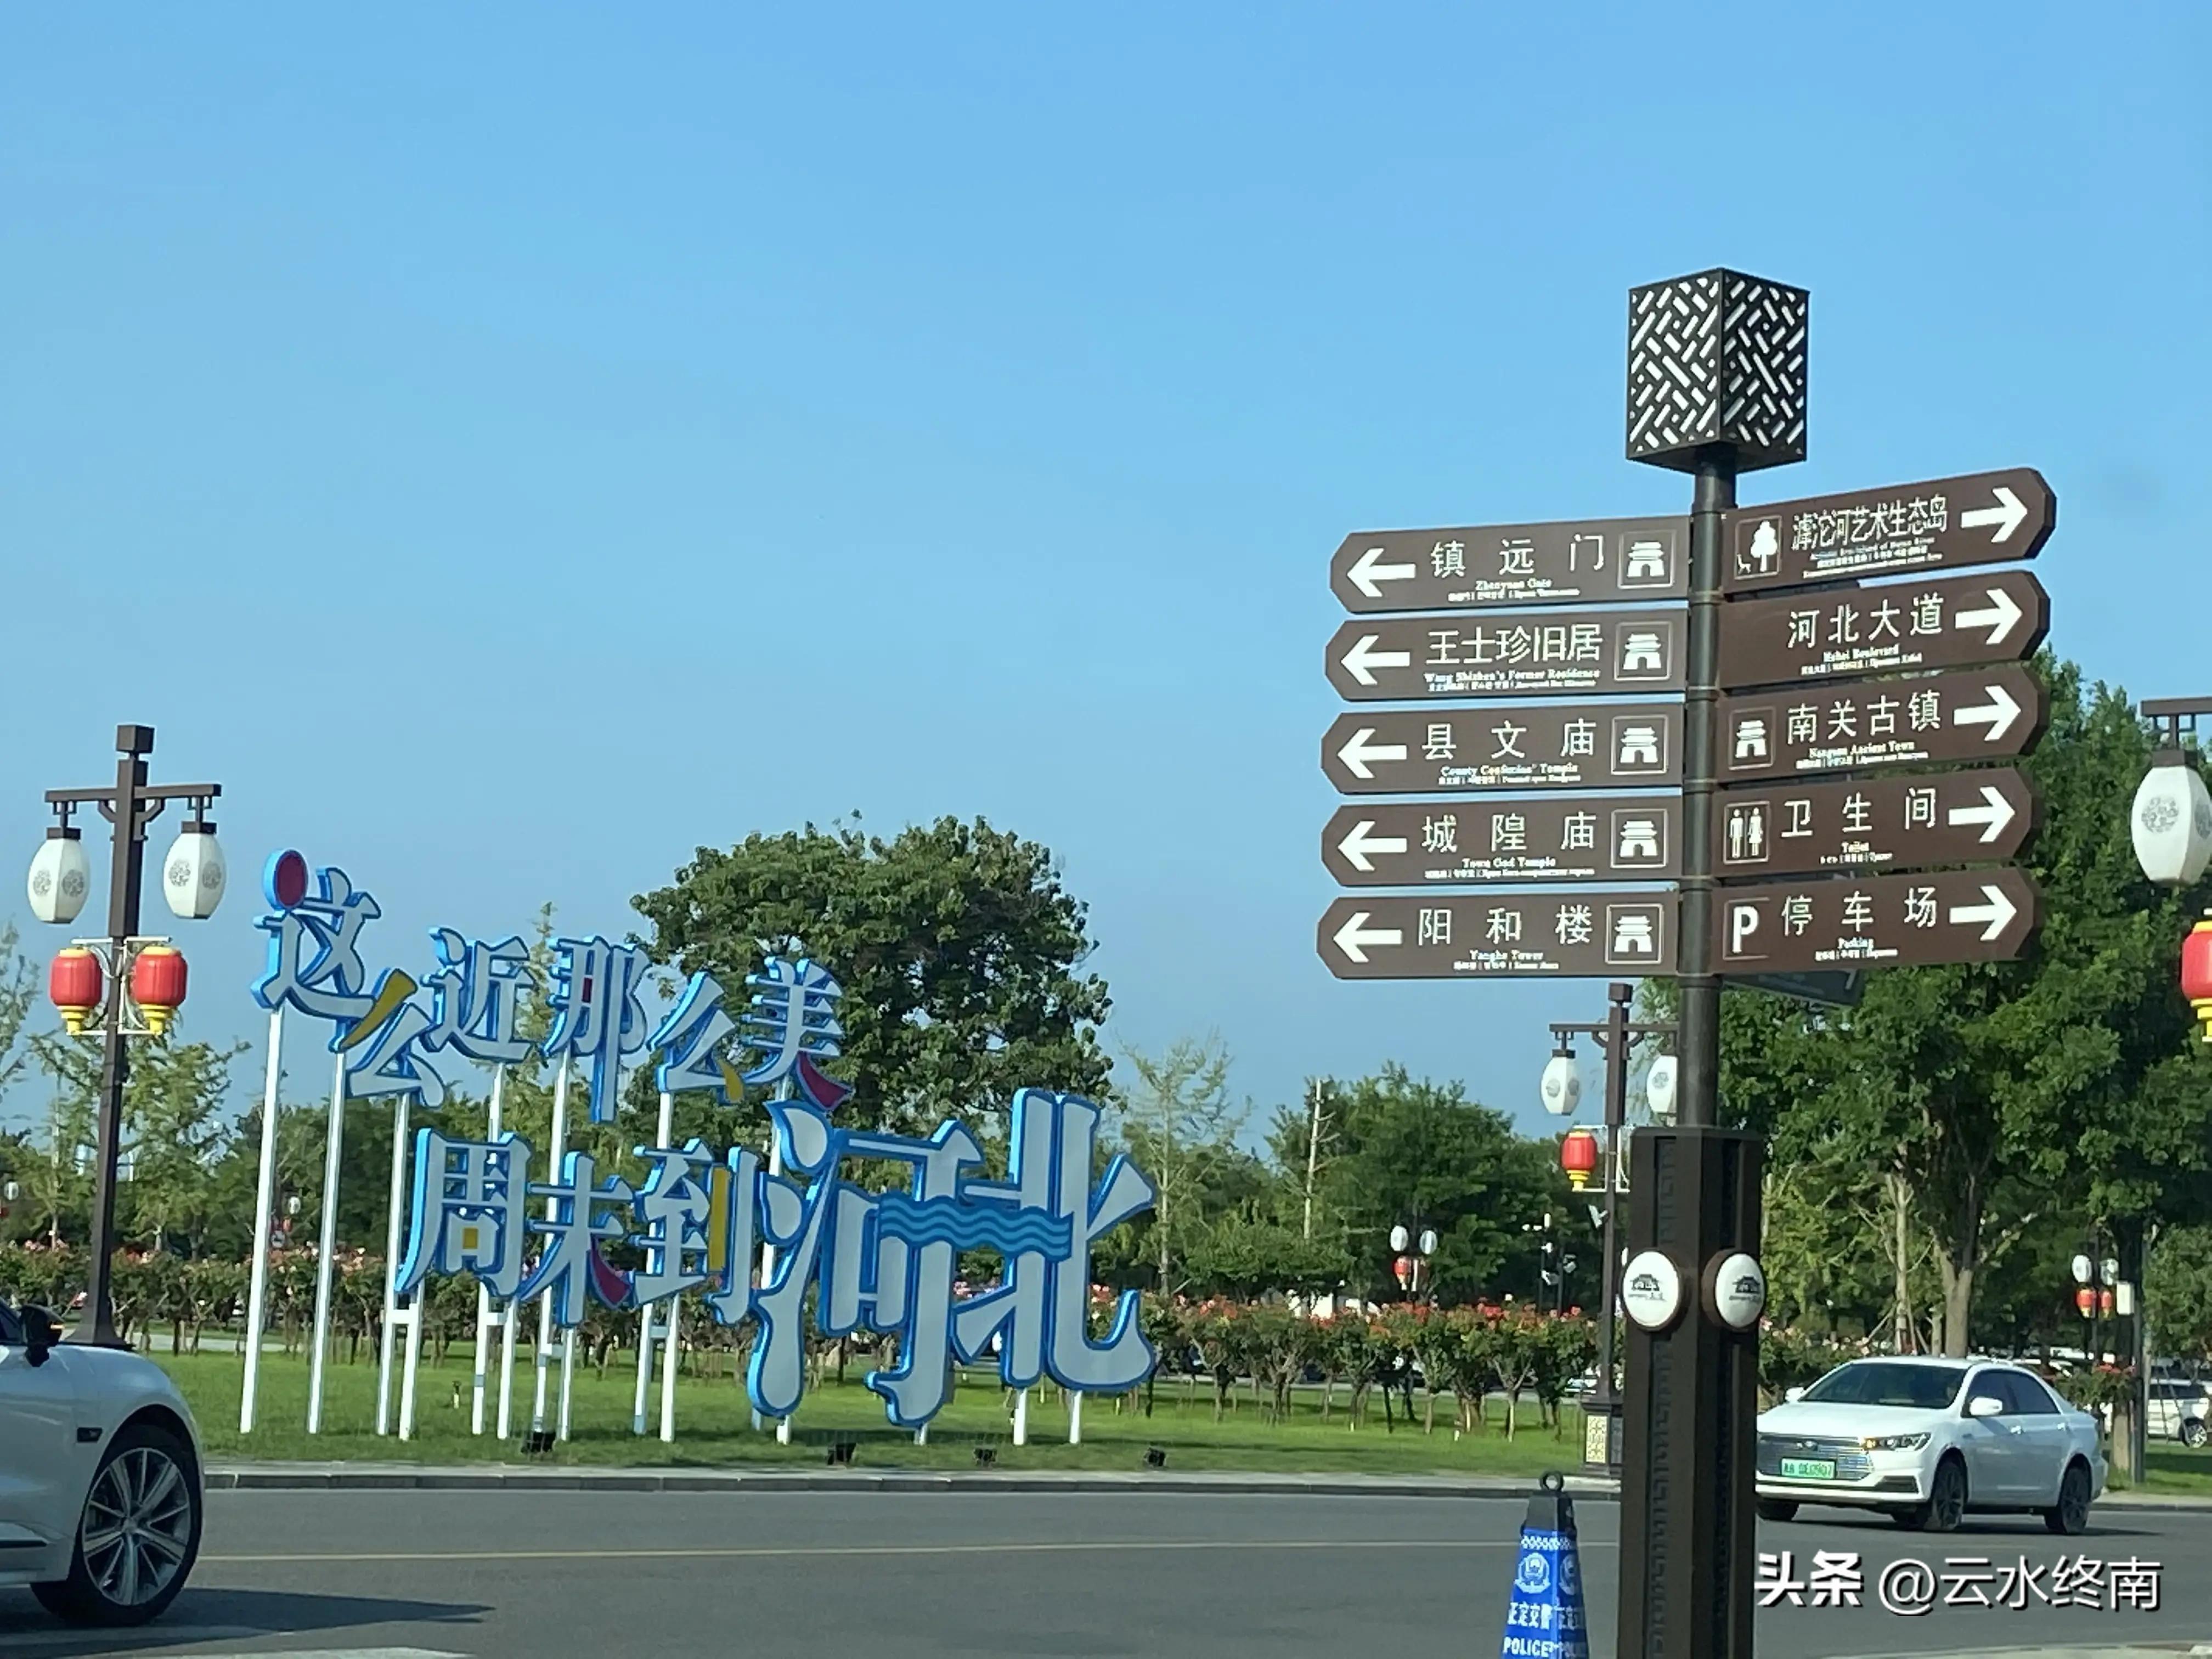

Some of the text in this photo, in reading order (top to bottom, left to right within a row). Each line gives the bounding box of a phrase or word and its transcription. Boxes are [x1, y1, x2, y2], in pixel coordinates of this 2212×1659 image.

[1792, 493, 1948, 551] 滹沱河艺术生态岛
[1431, 534, 1605, 578] 镇远门
[1787, 592, 1944, 650] 河北大道
[1426, 624, 1604, 665] 王士珍旧居
[1548, 668, 1601, 679] Residence
[1787, 689, 1942, 745] 南关古镇
[1422, 718, 1597, 760] 县文庙
[1888, 741, 1915, 752] Town
[1540, 762, 1579, 776] Temple
[1422, 811, 1597, 853] 城隍庙
[1781, 788, 1937, 838] 卫生间
[1517, 856, 1556, 868] Temple
[1419, 904, 1593, 946] 阳和楼
[1781, 887, 1937, 936] 停车场
[1511, 950, 1544, 961] Tower
[1503, 1636, 1549, 1658] POLICE
